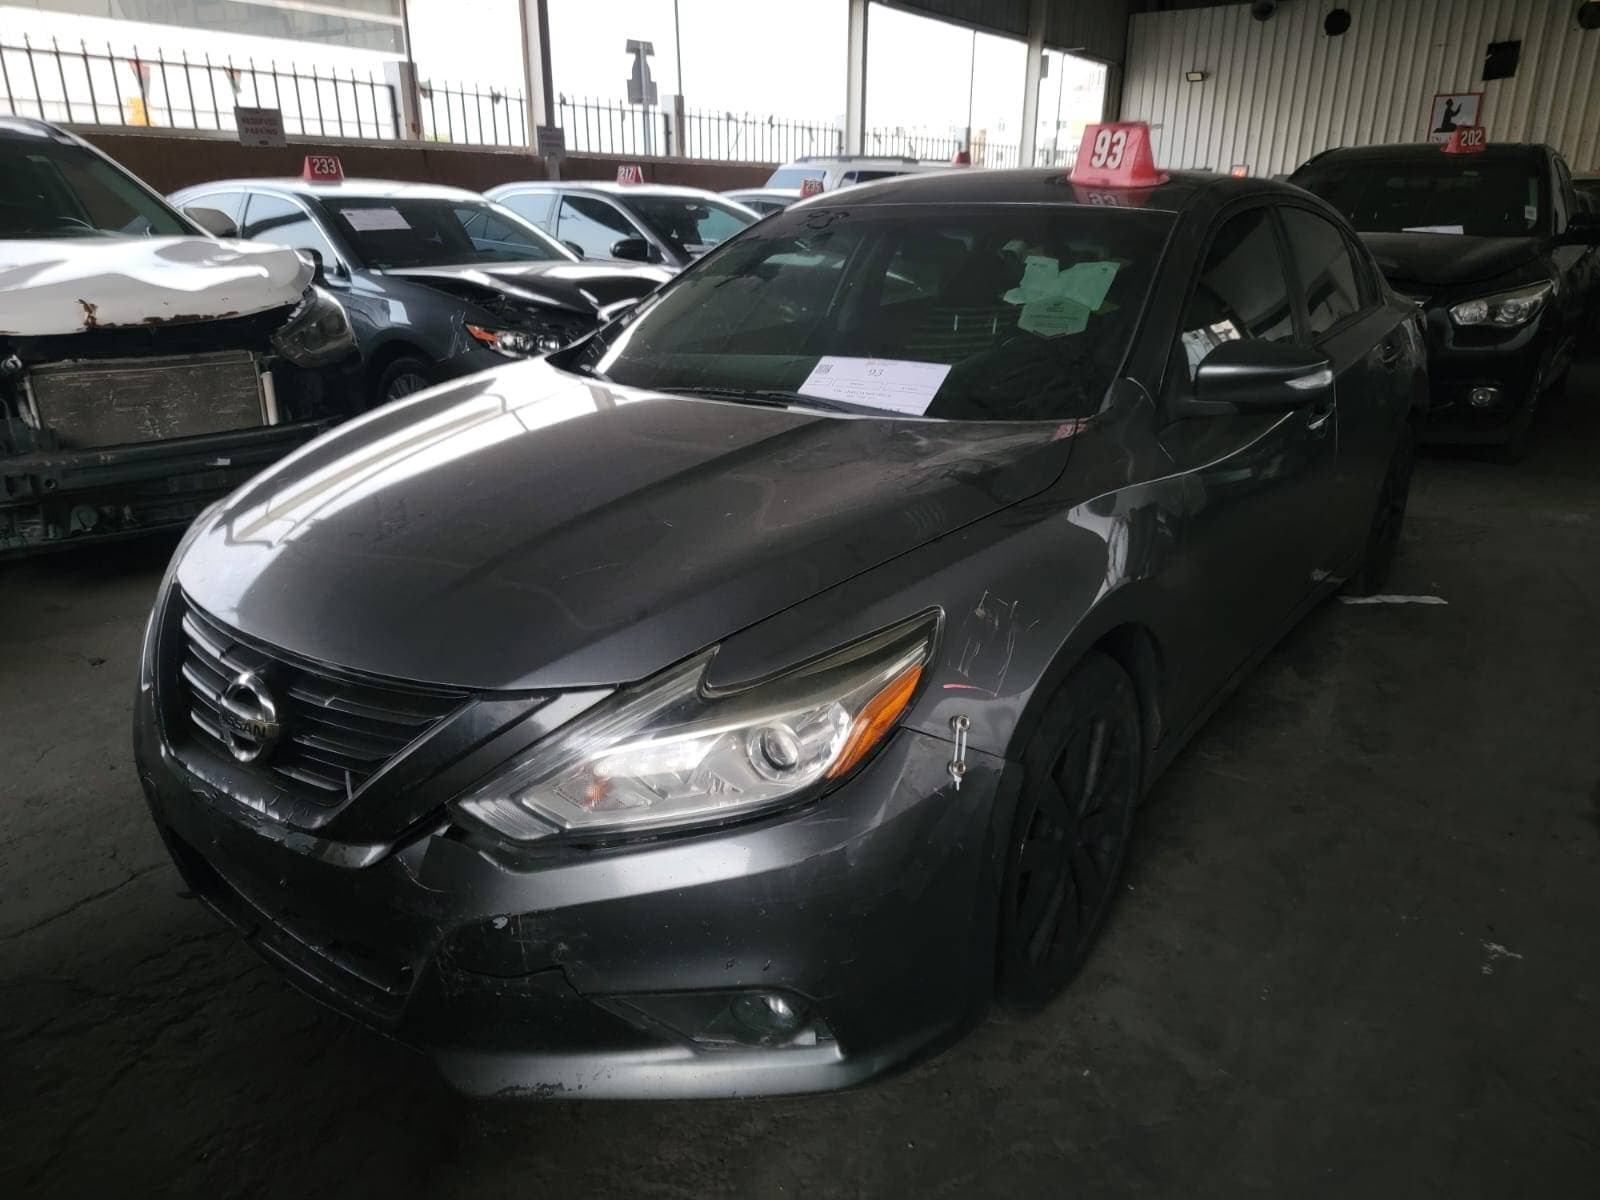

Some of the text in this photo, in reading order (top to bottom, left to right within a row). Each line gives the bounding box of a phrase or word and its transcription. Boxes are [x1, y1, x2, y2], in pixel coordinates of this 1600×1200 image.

[1461, 130, 1482, 146] 202
[1091, 129, 1127, 169] 93
[313, 158, 336, 174] 233
